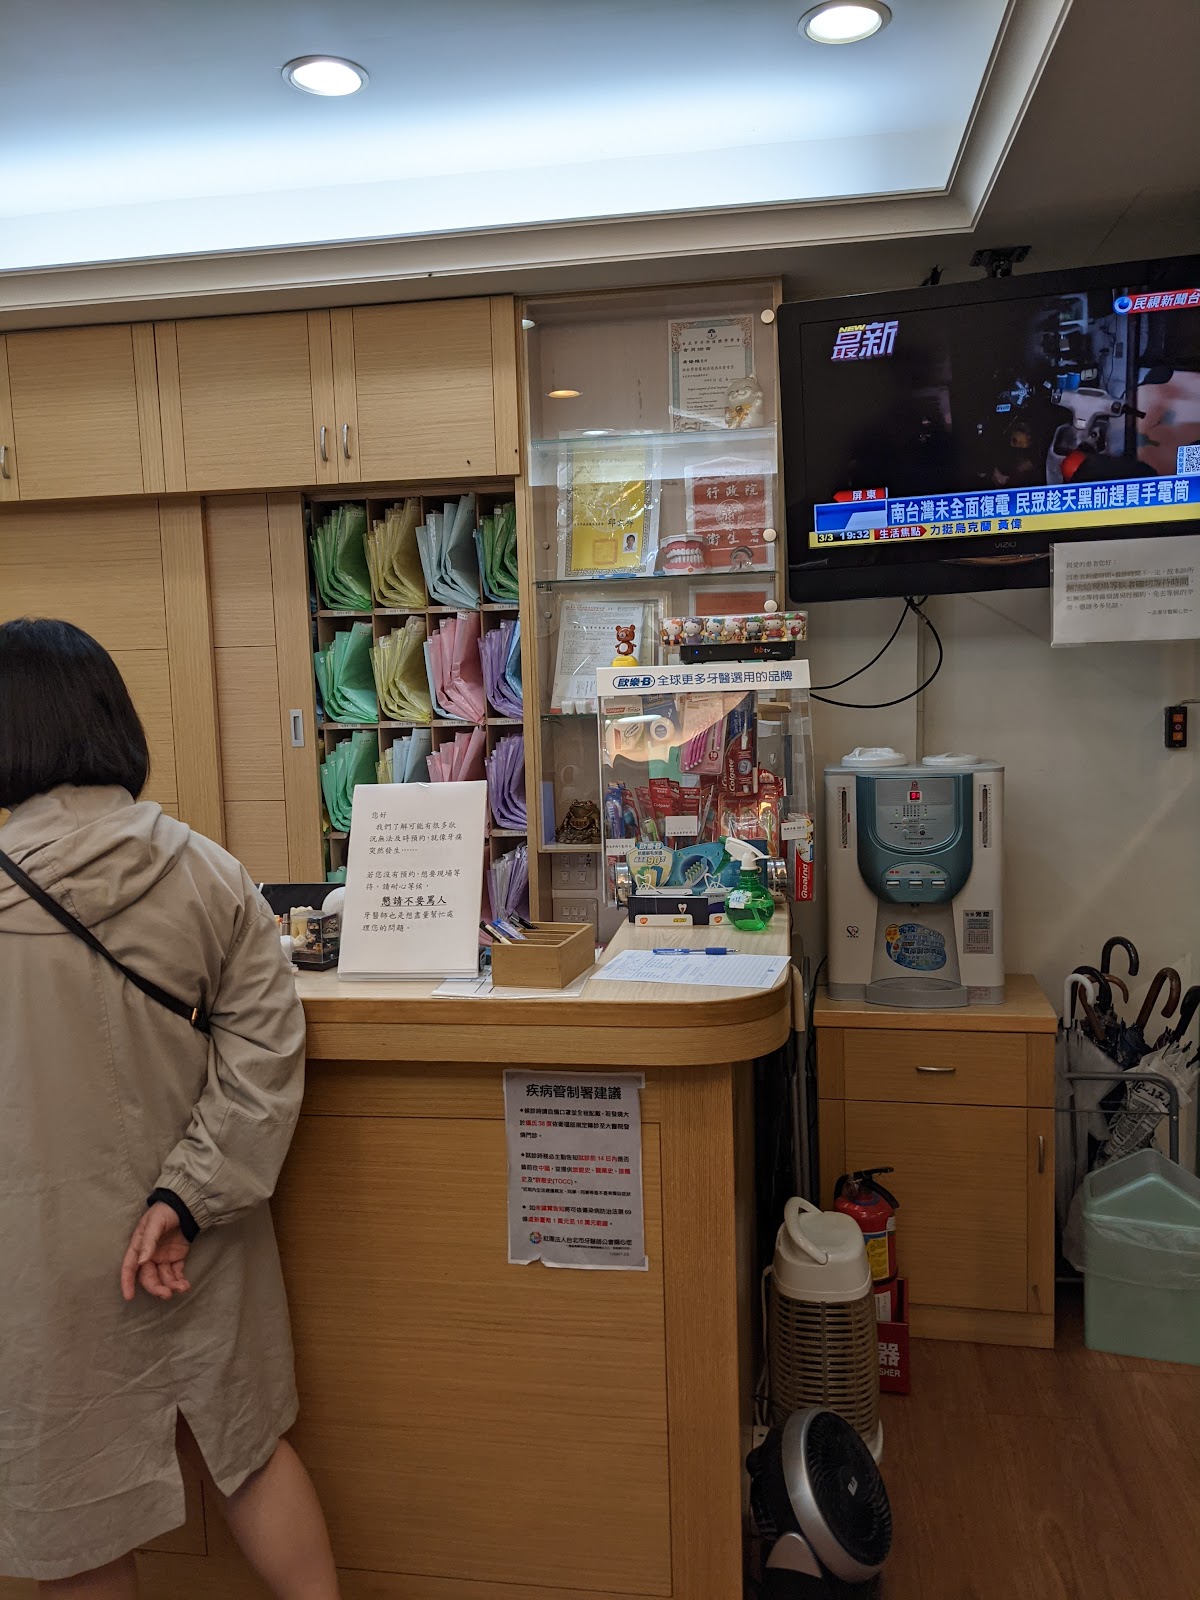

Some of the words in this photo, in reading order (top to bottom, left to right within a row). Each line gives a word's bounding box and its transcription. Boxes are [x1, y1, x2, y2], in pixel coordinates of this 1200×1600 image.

[838, 324, 866, 333] NEW
[831, 320, 899, 360] 最新
[706, 483, 759, 500] 行政院
[852, 489, 877, 501] 屏東
[890, 497, 1010, 525] 南台灣未全面復電
[1016, 479, 1190, 517] 民眾趁天黑前趕買手電筒
[879, 527, 921, 539] 生活焦點
[930, 521, 992, 535] 力挺烏克蘭
[818, 534, 834, 542] 3/3
[839, 530, 870, 540] 19:32
[994, 541, 1017, 549] VIZIO
[753, 645, 771, 653] bbtv
[657, 670, 793, 686] 全球更多牙醫選用的品牌
[728, 758, 736, 792] Colgate
[371, 811, 387, 819] 您好
[376, 822, 457, 831] 我們了解可能有很多狀
[380, 895, 447, 907] 懇請不要罵人
[363, 910, 454, 920] 牙醫師也是想盡量幫忙處
[362, 923, 411, 932] 理您的問題。
[526, 1084, 622, 1100] 疾病管制署建議
